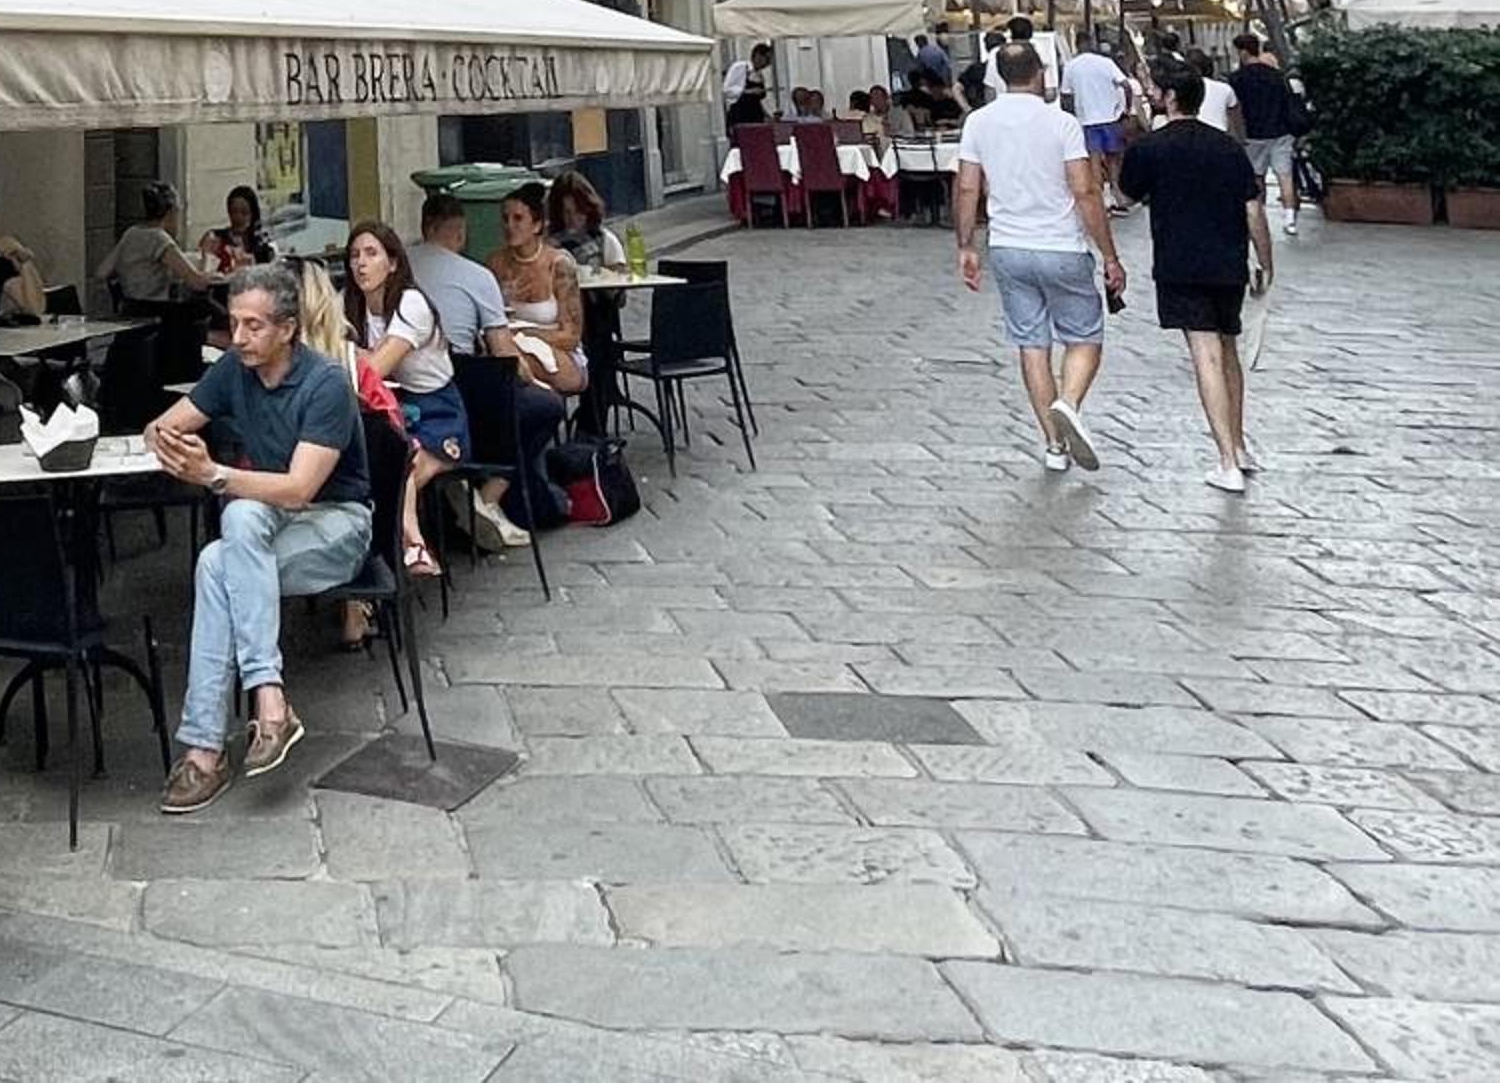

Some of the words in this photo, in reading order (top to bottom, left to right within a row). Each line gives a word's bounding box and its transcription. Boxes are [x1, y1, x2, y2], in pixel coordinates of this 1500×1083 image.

[284, 53, 344, 106] BAR
[352, 53, 437, 104] BRERA
[451, 54, 565, 103] COCKTAIL
